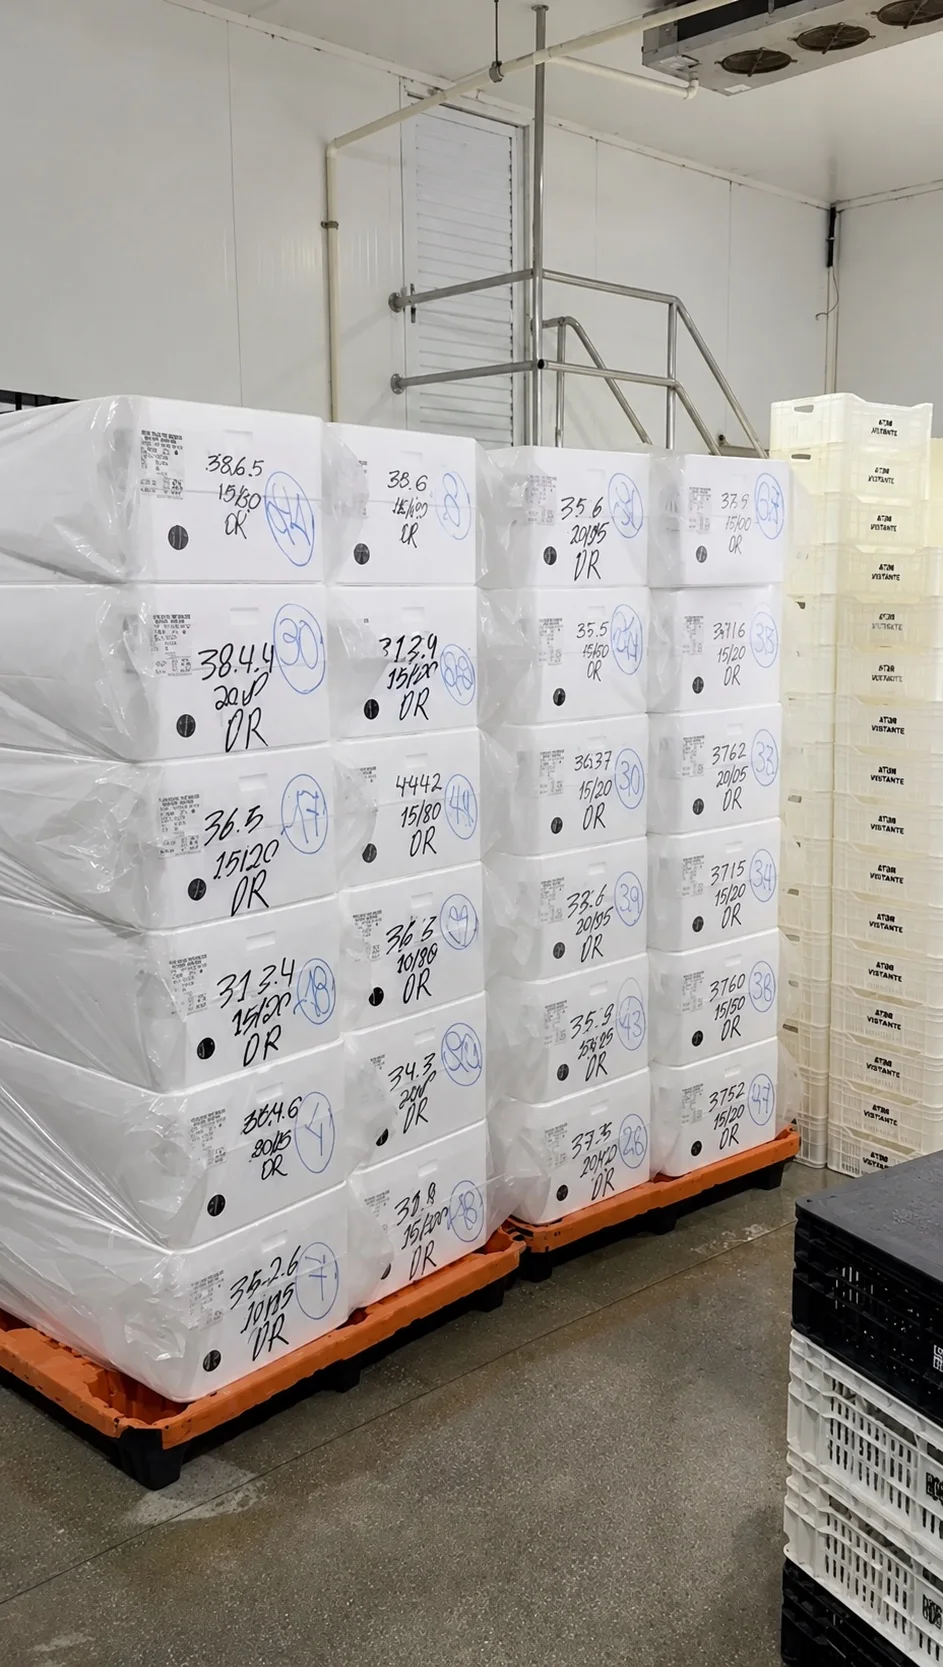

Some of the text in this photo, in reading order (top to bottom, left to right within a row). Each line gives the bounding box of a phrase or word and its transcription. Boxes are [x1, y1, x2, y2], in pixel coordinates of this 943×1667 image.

[576, 621, 610, 639] 35.5
[717, 643, 746, 665] 15/20
[871, 725, 905, 735] VISTANTE
[712, 742, 747, 766] 3762
[395, 772, 443, 798] 4442
[716, 764, 749, 788] 20/05
[870, 774, 905, 785] VISTANTE
[579, 776, 613, 803] 15/20
[400, 799, 442, 828] 15/80
[870, 823, 905, 835] VISTANTE
[711, 859, 746, 886] 3715
[869, 872, 904, 884] VISTANTE
[714, 883, 746, 907] 15/20
[869, 920, 903, 934] VISTANTE
[709, 973, 746, 1002] 3760
[868, 969, 902, 983] VISTANTE
[714, 995, 746, 1021] 15/50
[866, 1015, 901, 1030] VISTANTE
[388, 1052, 436, 1091] 34.3
[866, 1062, 900, 1078] VISTANTE
[708, 1082, 745, 1113] 3752
[751, 1082, 770, 1115] 47
[713, 1104, 745, 1130] 15/20
[863, 1110, 898, 1126] VISTANTE
